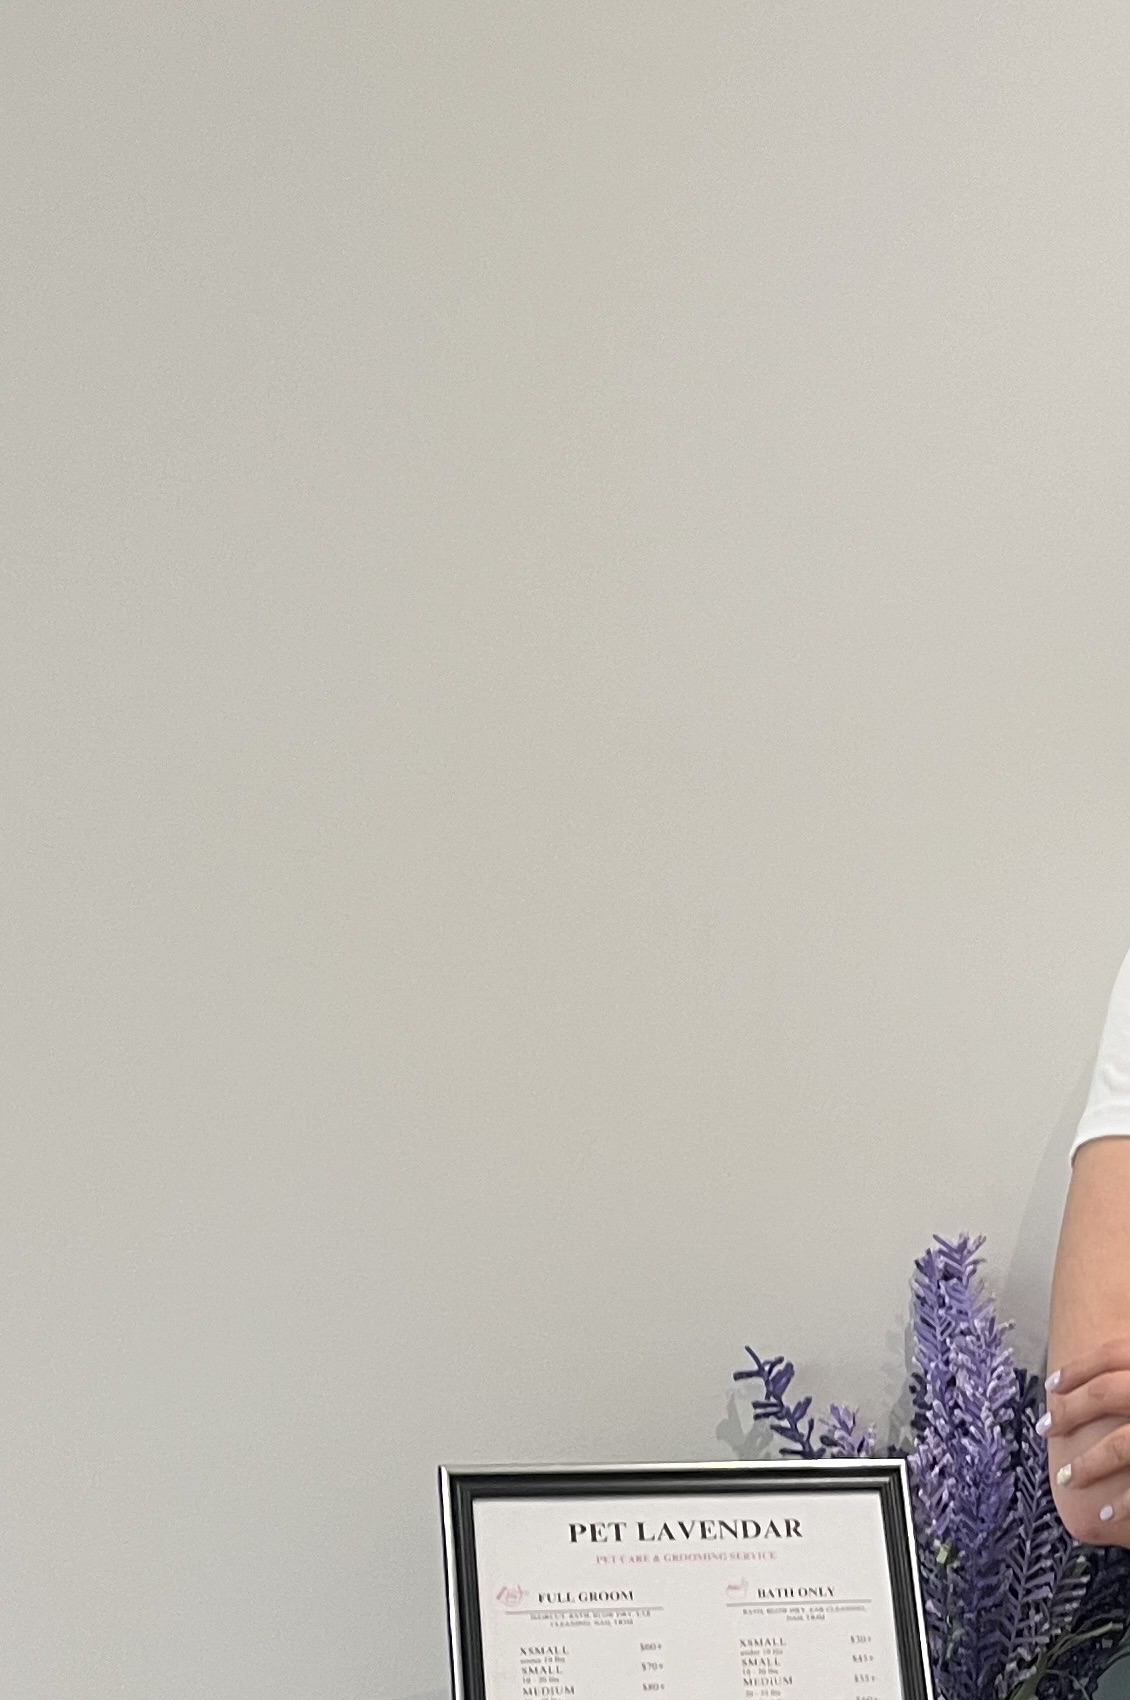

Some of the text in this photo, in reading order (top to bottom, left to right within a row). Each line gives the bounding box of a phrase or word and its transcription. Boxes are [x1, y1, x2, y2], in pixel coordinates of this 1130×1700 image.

[568, 1517, 803, 1543] PET LAVENDAR
[538, 1590, 635, 1603] FULL GROOM
[756, 1585, 836, 1599] BATH ONLY
[739, 1637, 787, 1648] XSMALL
[519, 1645, 569, 1656] XSMALL
[741, 1658, 781, 1668] SMALL
[521, 1665, 564, 1675] SMALL
[743, 1676, 793, 1687] MEDIUM
[521, 1684, 575, 1696] MEDIUM
